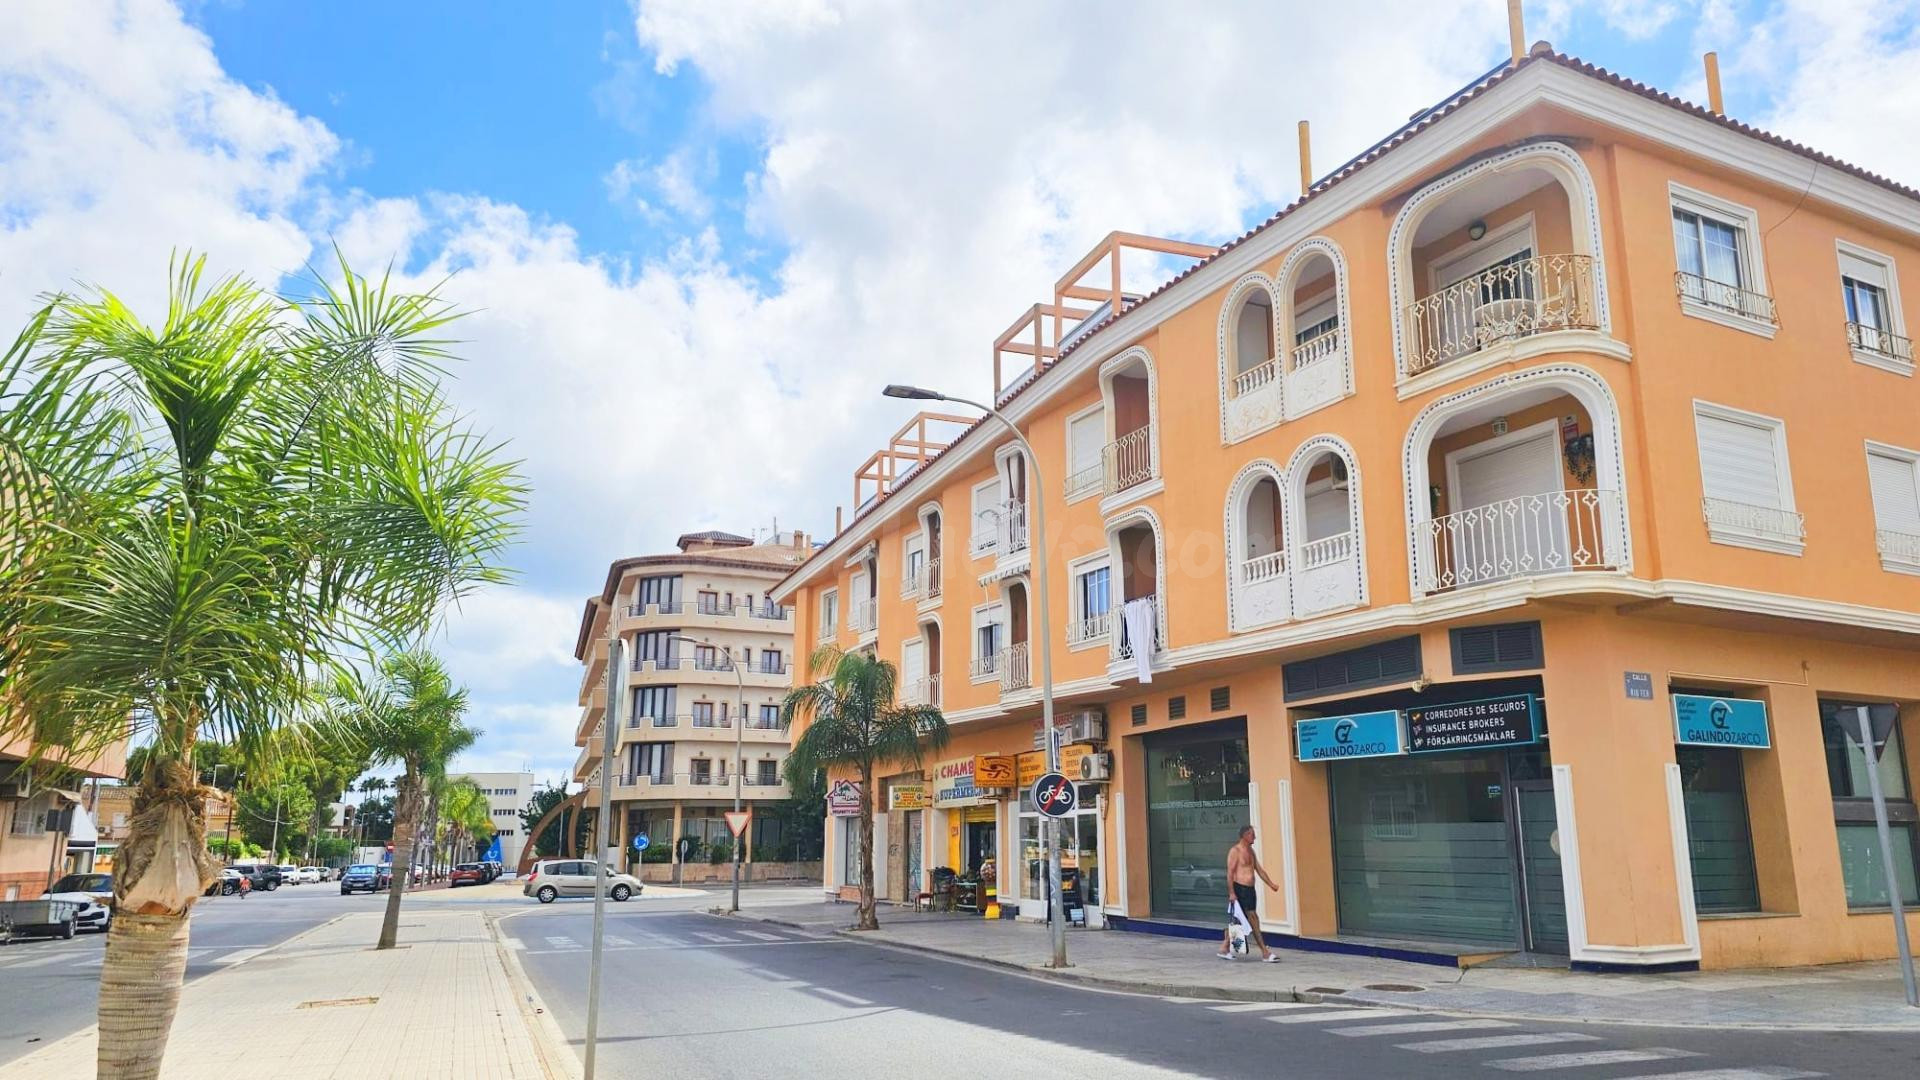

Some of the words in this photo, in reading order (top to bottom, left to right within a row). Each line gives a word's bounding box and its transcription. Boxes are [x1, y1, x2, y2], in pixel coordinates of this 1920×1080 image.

[1425, 708, 1474, 721] CORREDORES
[1476, 705, 1486, 716] DE
[1489, 701, 1526, 714] SEGUROS
[1425, 721, 1467, 733] INSURANCE
[1469, 717, 1505, 729] BROKERS
[1427, 730, 1516, 746] FÖRSÄKRINGSMÄKLARE
[1688, 729, 1761, 745] GALINDOZARCO
[1312, 742, 1386, 758] GALINDOZARCO
[941, 761, 974, 779] CHAMB
